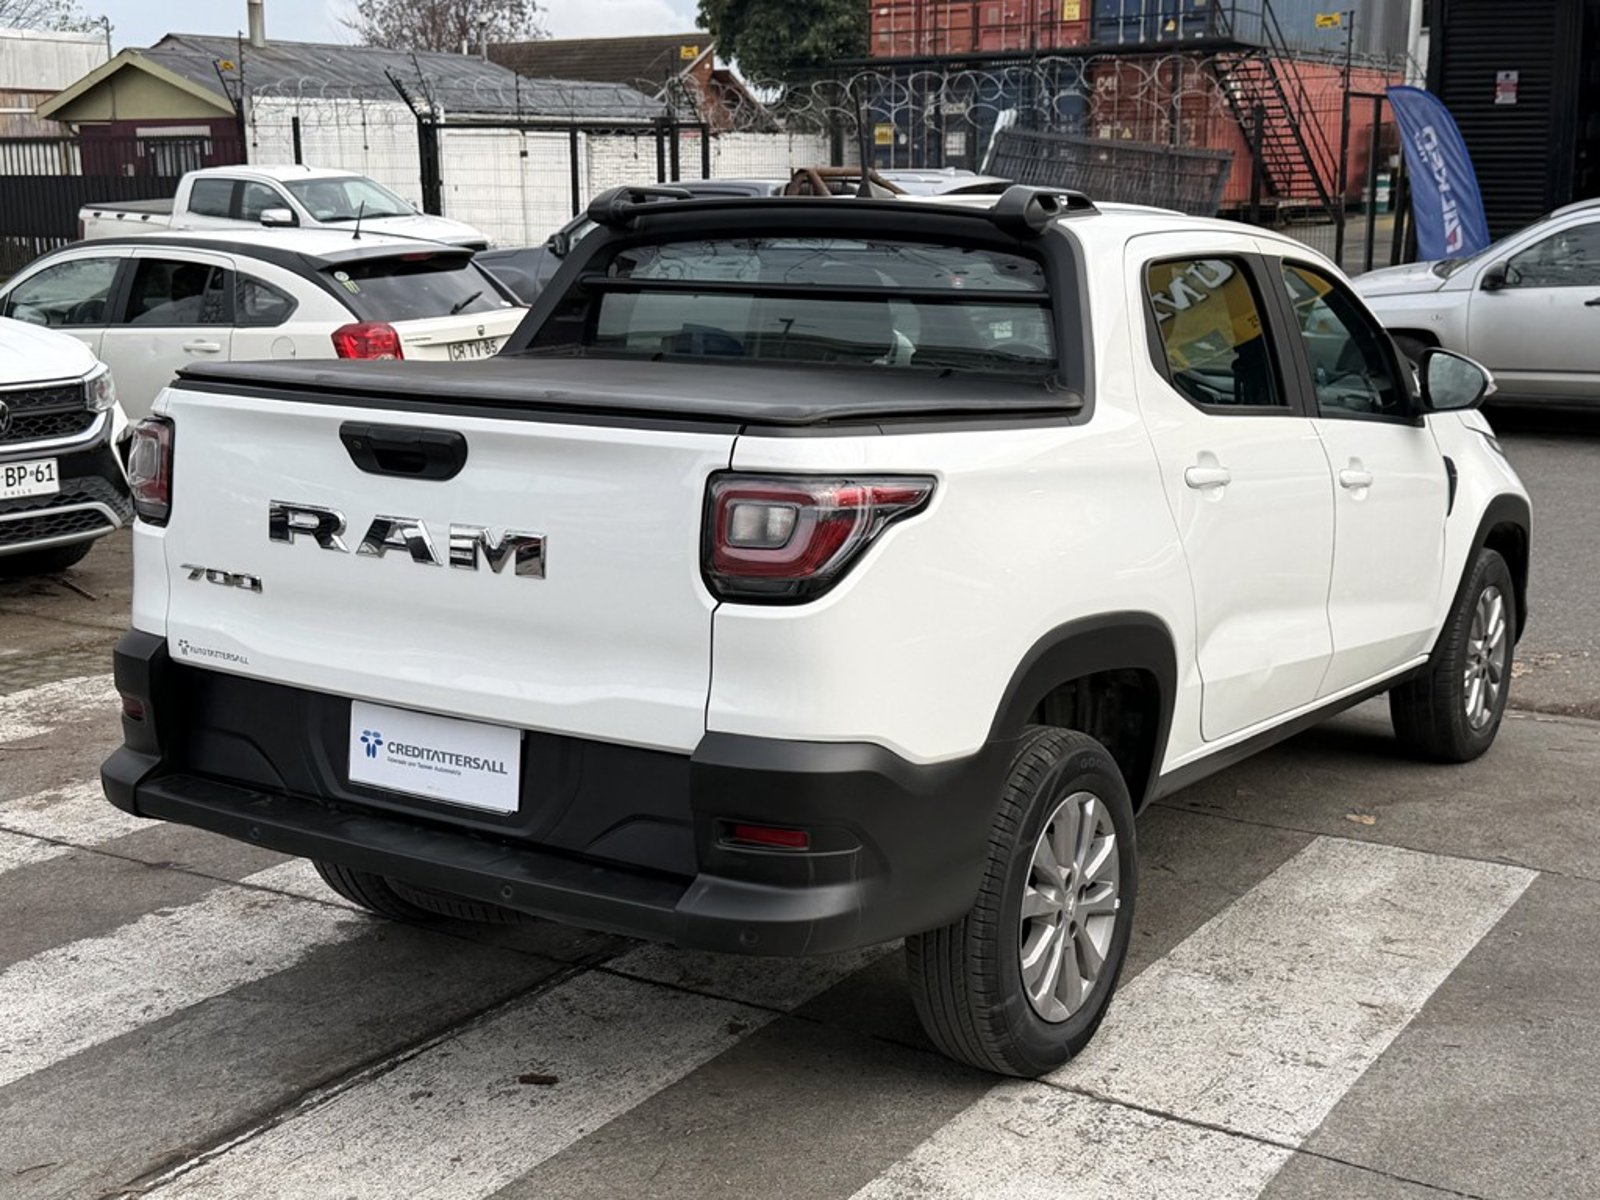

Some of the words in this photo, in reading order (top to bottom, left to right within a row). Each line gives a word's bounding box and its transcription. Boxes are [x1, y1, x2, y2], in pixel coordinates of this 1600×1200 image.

[269, 499, 548, 580] RAM
[180, 563, 263, 593] 700
[387, 741, 508, 775] CREDITATTERSALL
